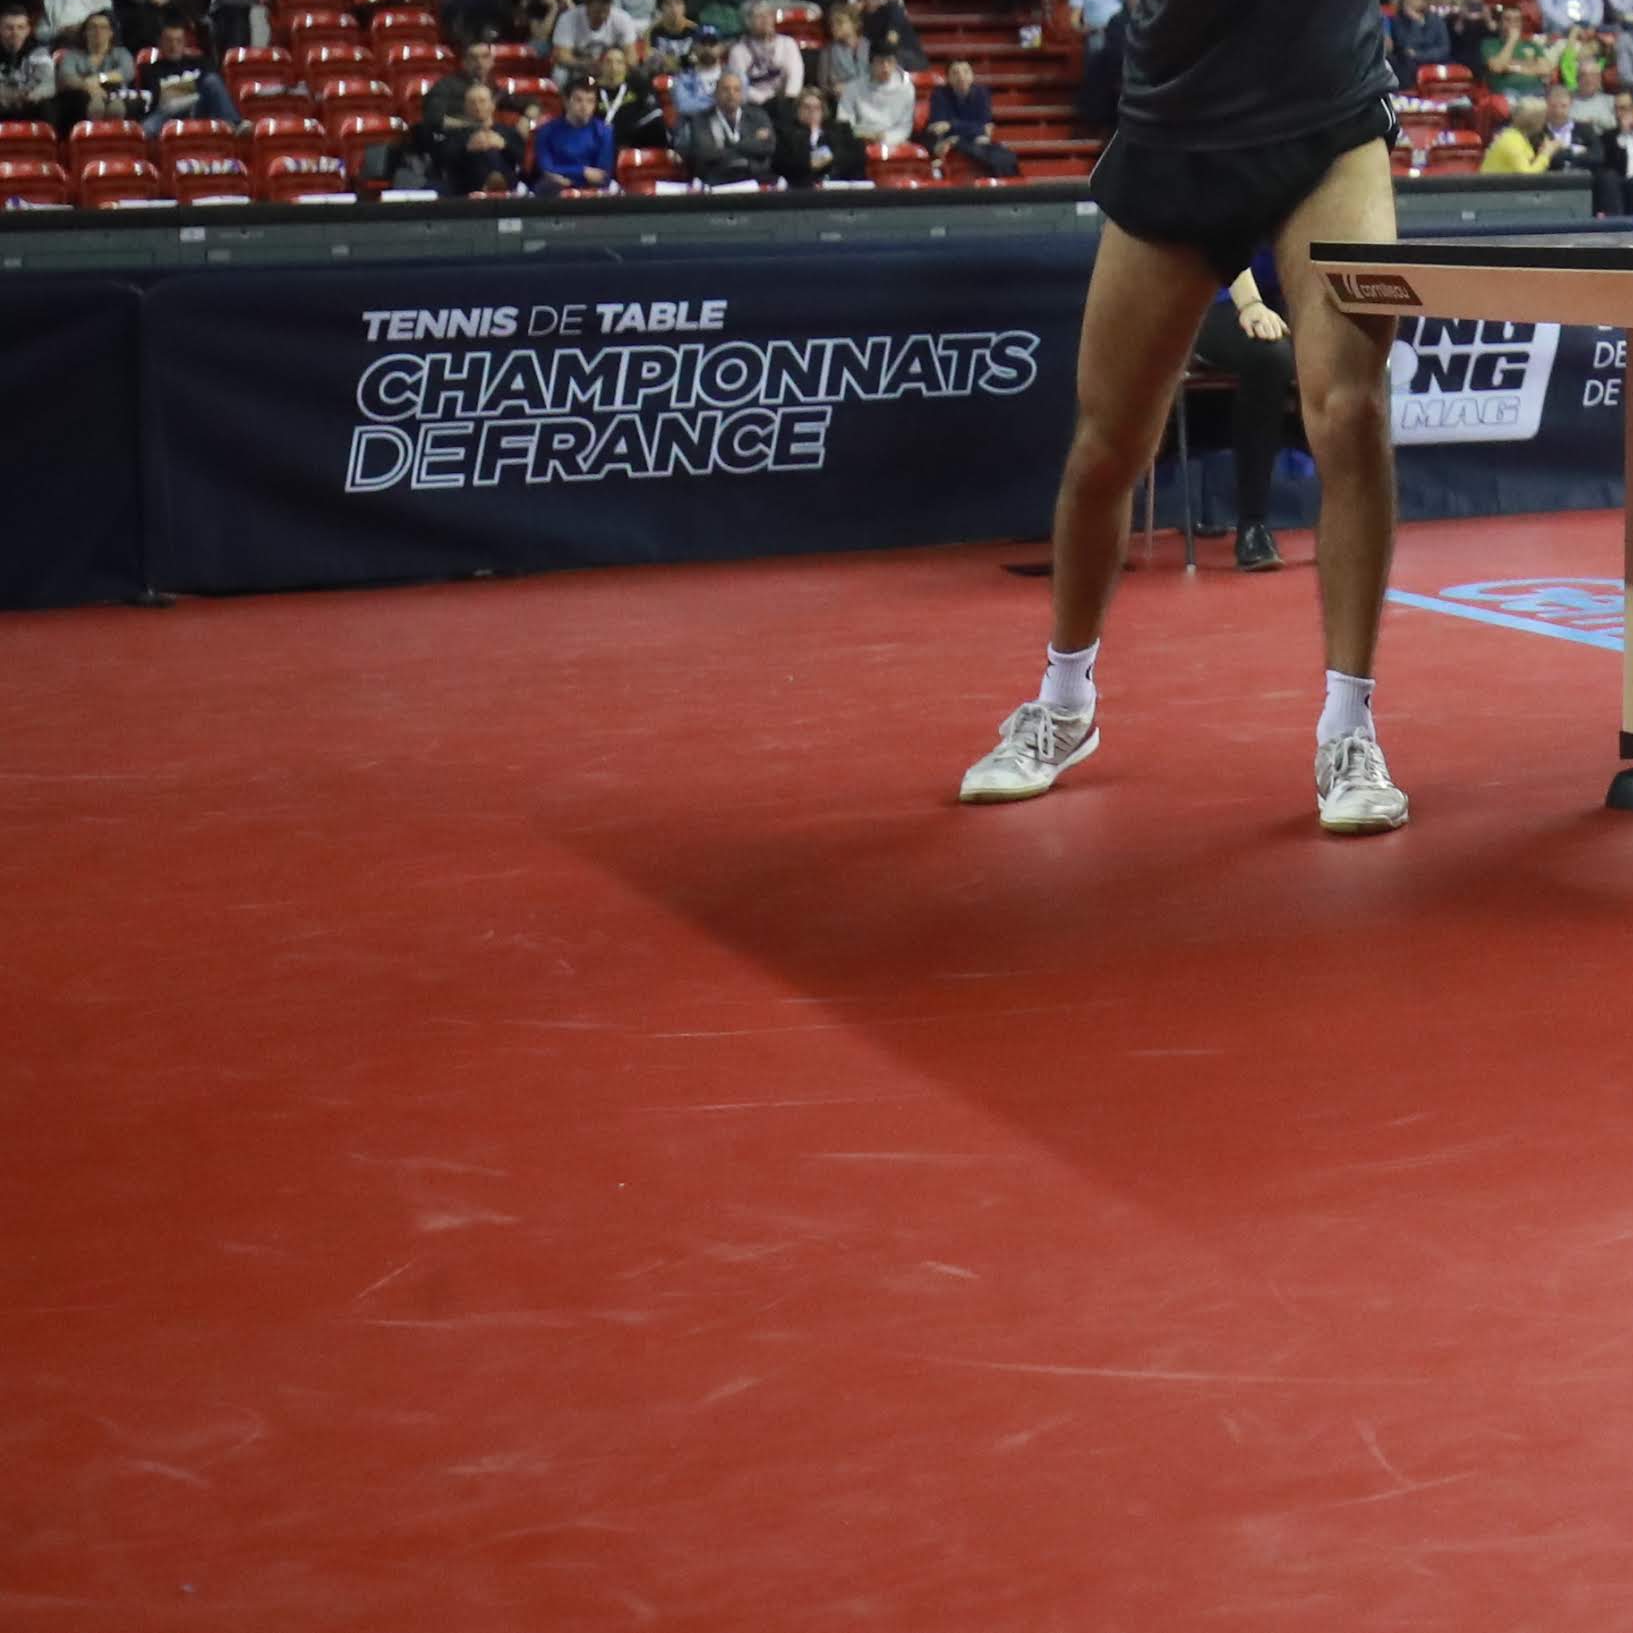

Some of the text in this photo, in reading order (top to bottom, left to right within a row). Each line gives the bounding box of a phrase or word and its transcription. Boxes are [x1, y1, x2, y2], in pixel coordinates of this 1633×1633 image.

[362, 300, 728, 342] TENNIS DE TABLE
[1593, 339, 1627, 369] DE
[356, 330, 1041, 422] CHAMPIONNATS
[1582, 378, 1622, 407] DE
[1402, 396, 1521, 430] MAG
[344, 405, 833, 493] DE FRANCE
